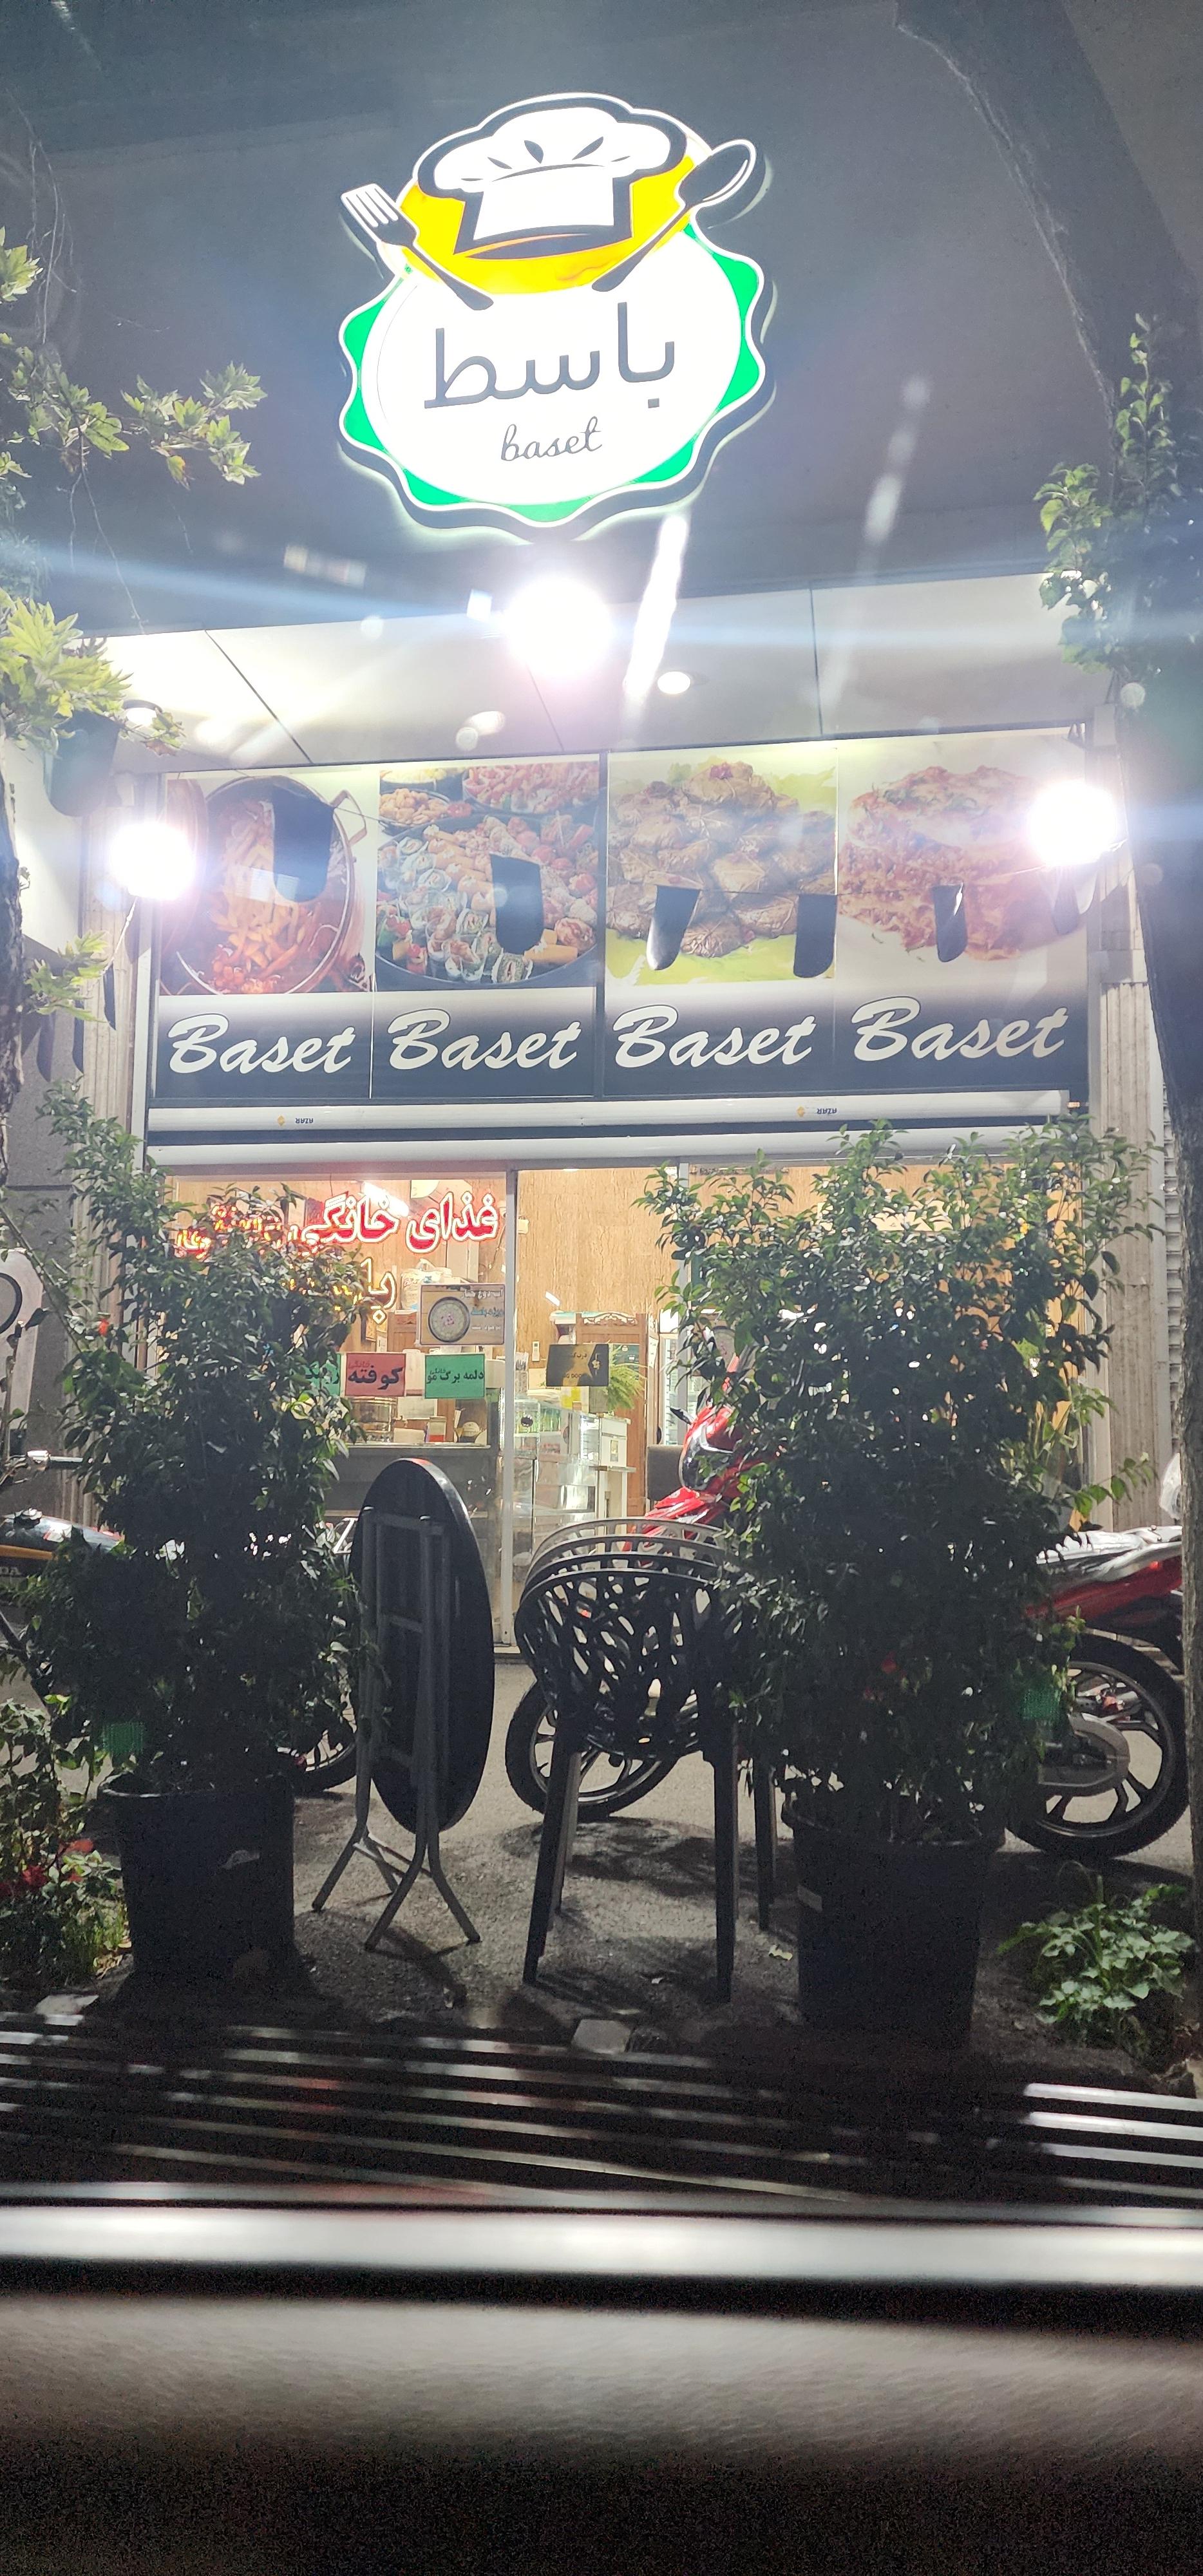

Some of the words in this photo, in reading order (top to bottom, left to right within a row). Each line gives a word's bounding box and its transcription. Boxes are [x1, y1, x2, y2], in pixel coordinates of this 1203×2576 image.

[424, 302, 676, 409] باسط
[500, 416, 604, 462] baset
[167, 1012, 357, 1074] Baset
[388, 1008, 582, 1070] Baset
[612, 1004, 817, 1068] Baset
[850, 996, 1069, 1062] Baset
[301, 1191, 400, 1256] خانگی
[406, 1191, 499, 1253] غذای
[348, 1365, 403, 1390] کوفته
[463, 1368, 484, 1380] دلمه
